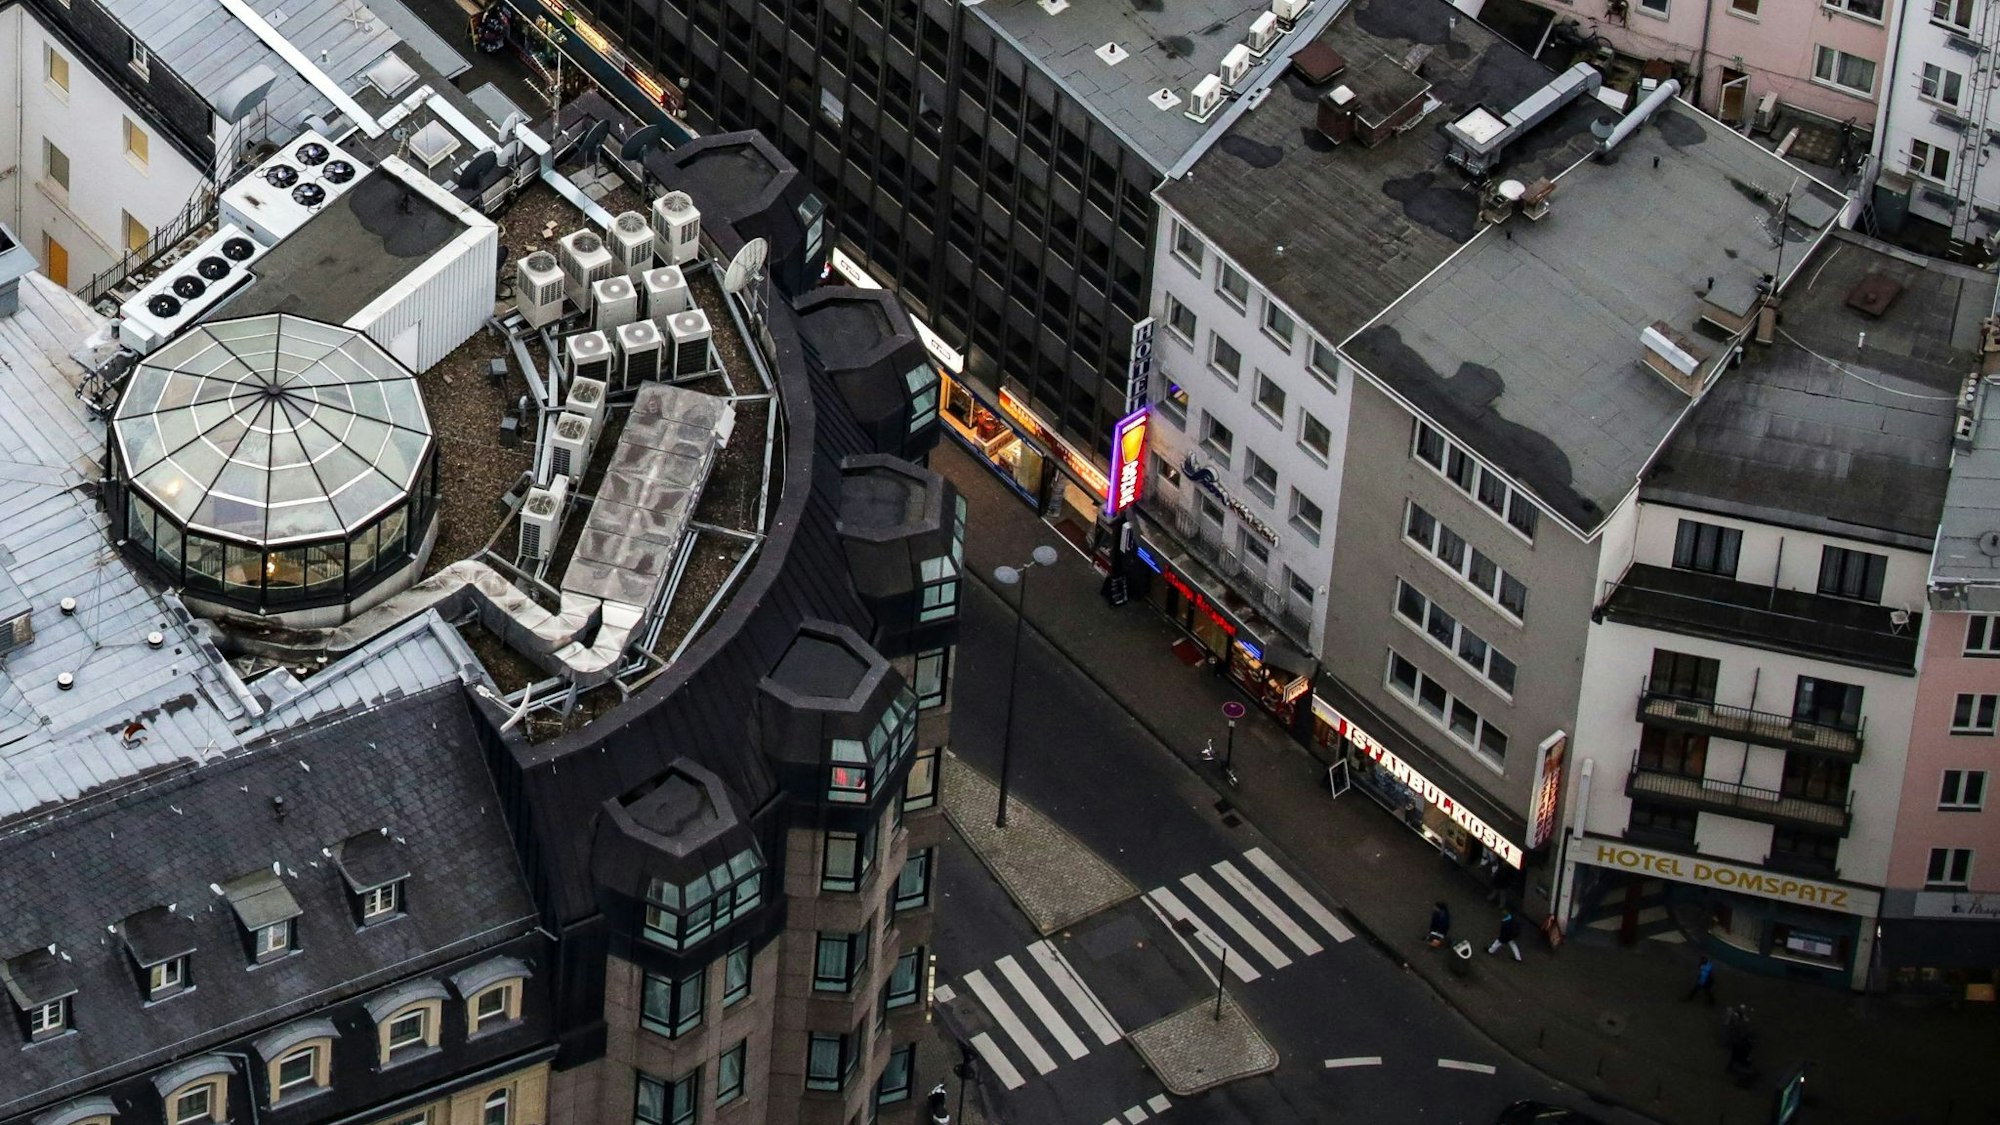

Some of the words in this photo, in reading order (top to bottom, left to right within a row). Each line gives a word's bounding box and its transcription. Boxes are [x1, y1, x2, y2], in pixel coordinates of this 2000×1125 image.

[1133, 324, 1151, 411] HOTEL
[1597, 845, 1684, 877] HOTEL
[1694, 863, 1848, 908] DOMSPATZ
